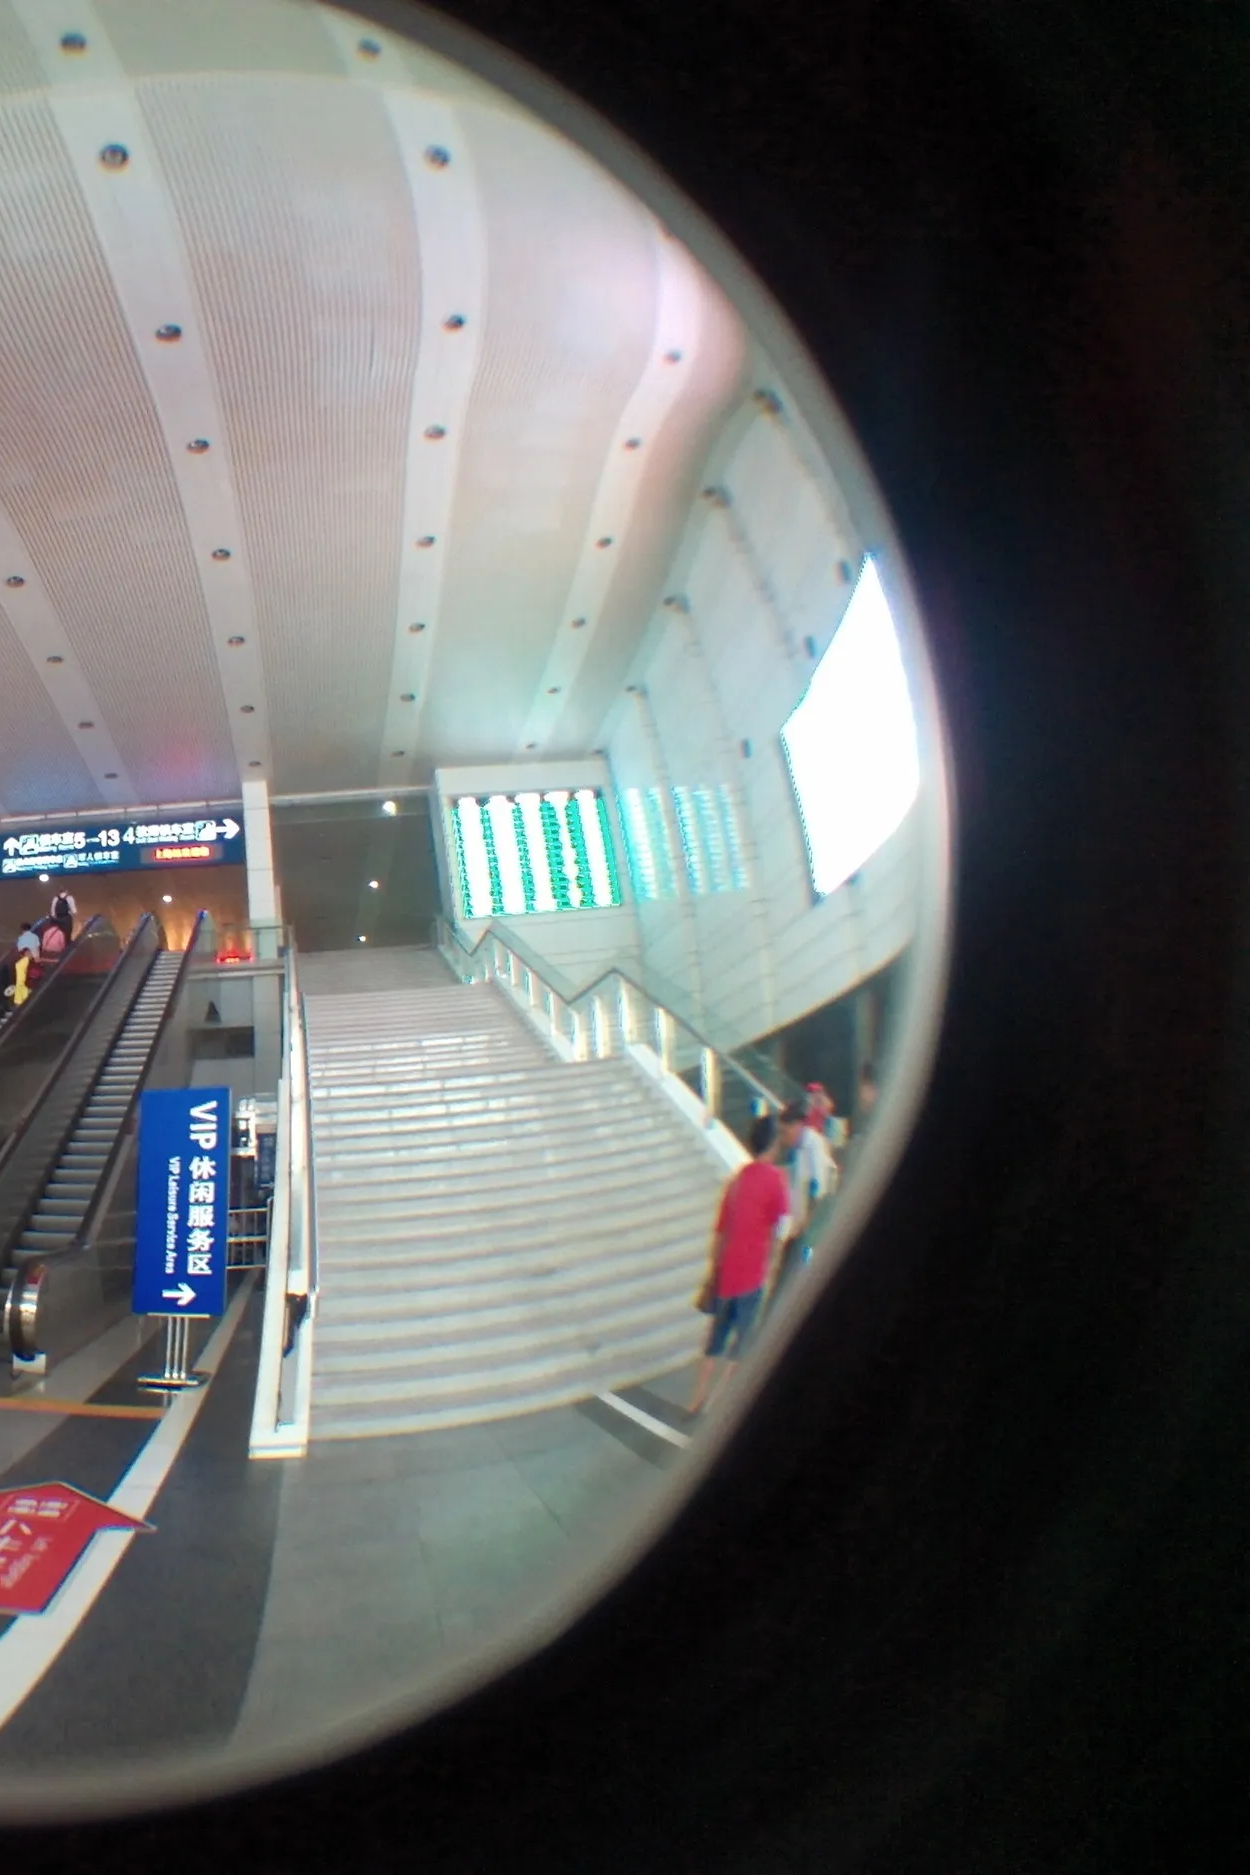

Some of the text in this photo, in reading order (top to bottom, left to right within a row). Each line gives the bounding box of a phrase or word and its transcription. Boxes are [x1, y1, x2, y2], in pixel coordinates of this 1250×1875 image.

[164, 1156, 182, 1274] VIP Leisure Service Area
[186, 1100, 218, 1275] VIP 休闲服务区
